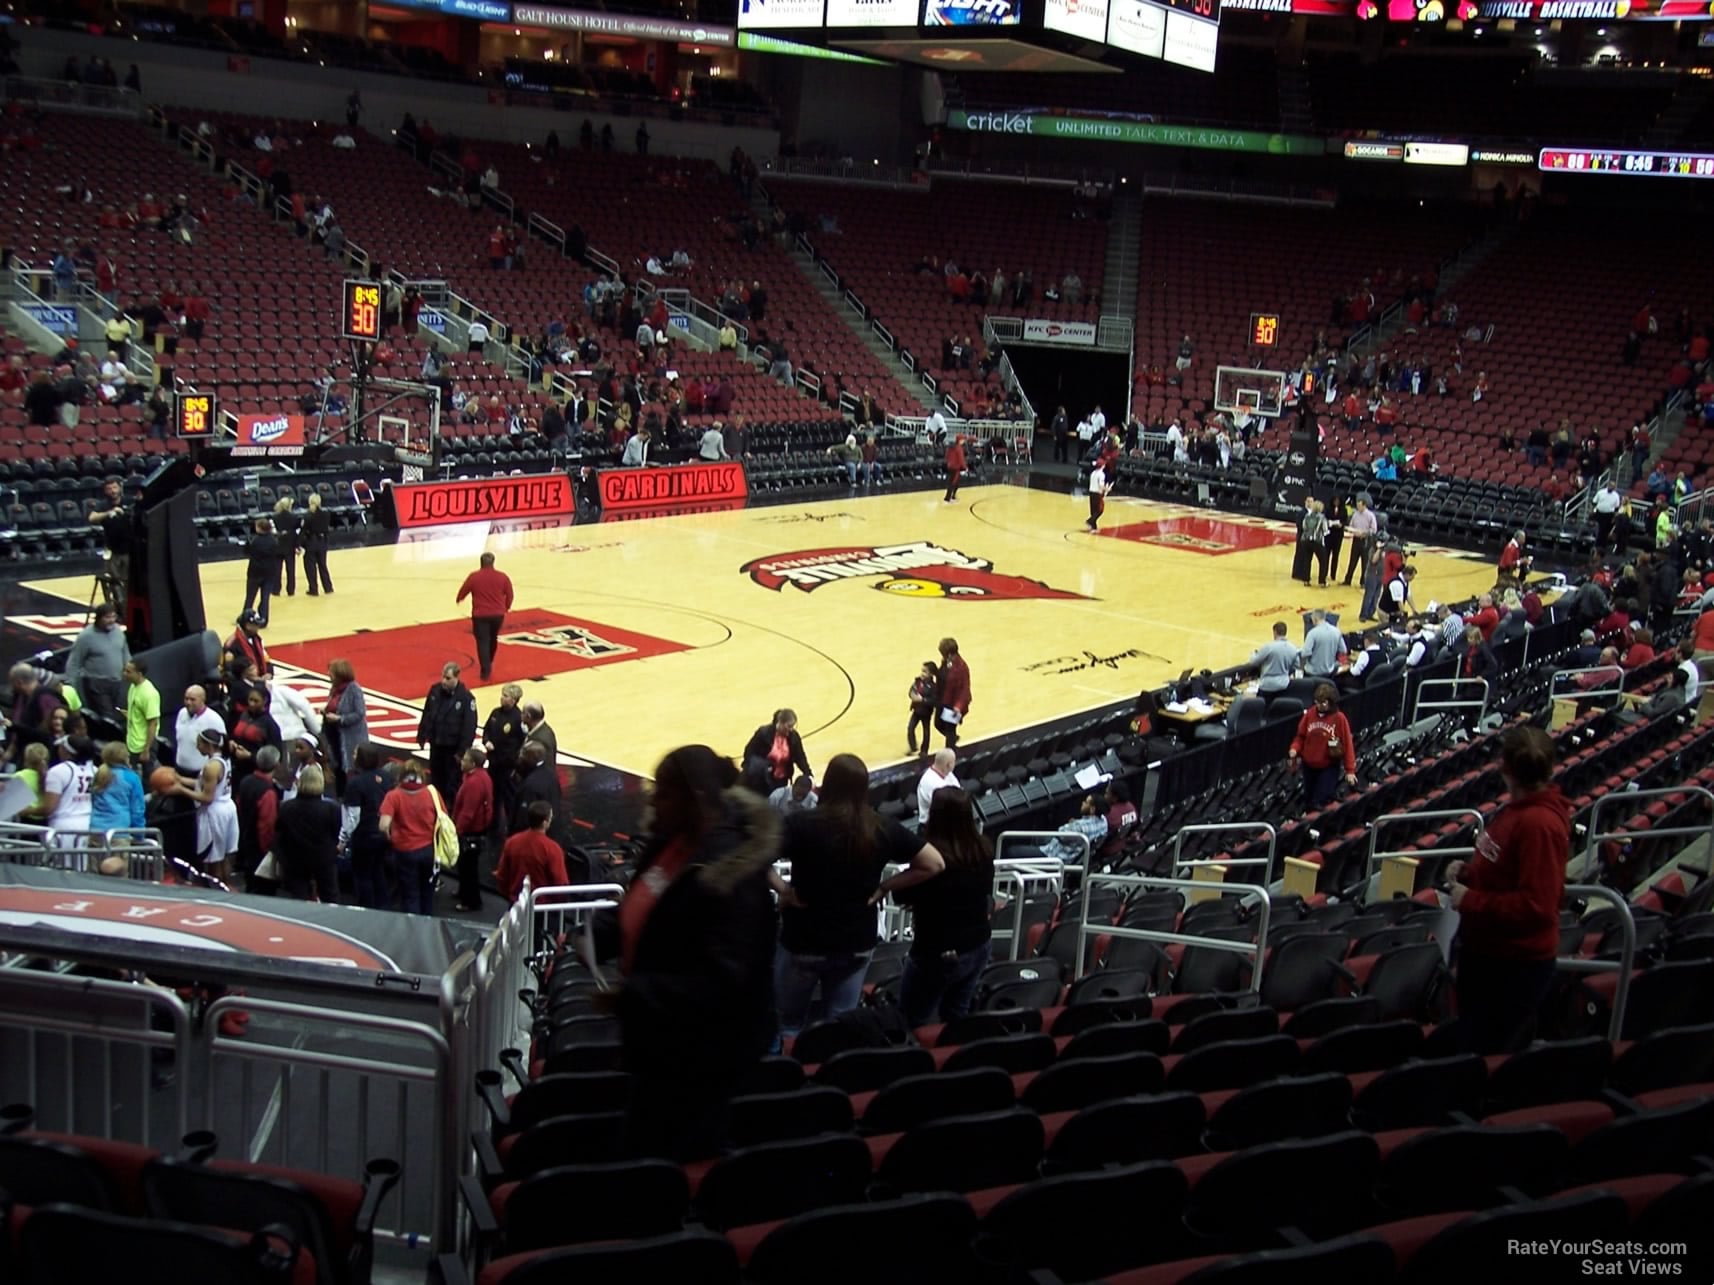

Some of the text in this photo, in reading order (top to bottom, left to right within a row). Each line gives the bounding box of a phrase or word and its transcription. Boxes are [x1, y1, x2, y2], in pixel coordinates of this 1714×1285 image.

[516, 9, 545, 23] GALT
[546, 12, 583, 27] HOUSE
[585, 15, 621, 31] HOTEL
[1540, 1, 1616, 18] BASKETBALL
[966, 112, 1033, 134] cricket
[1056, 121, 1122, 137] UNLIMITED
[1210, 133, 1245, 147] DATA
[355, 286, 379, 306] 8:45
[352, 302, 375, 334] 30
[1064, 328, 1093, 337] CENTER
[1255, 325, 1274, 344] 30
[184, 412, 205, 431] 30
[251, 416, 289, 440] Dean's
[408, 466, 738, 522] LOUISVILLE CARDINALS
